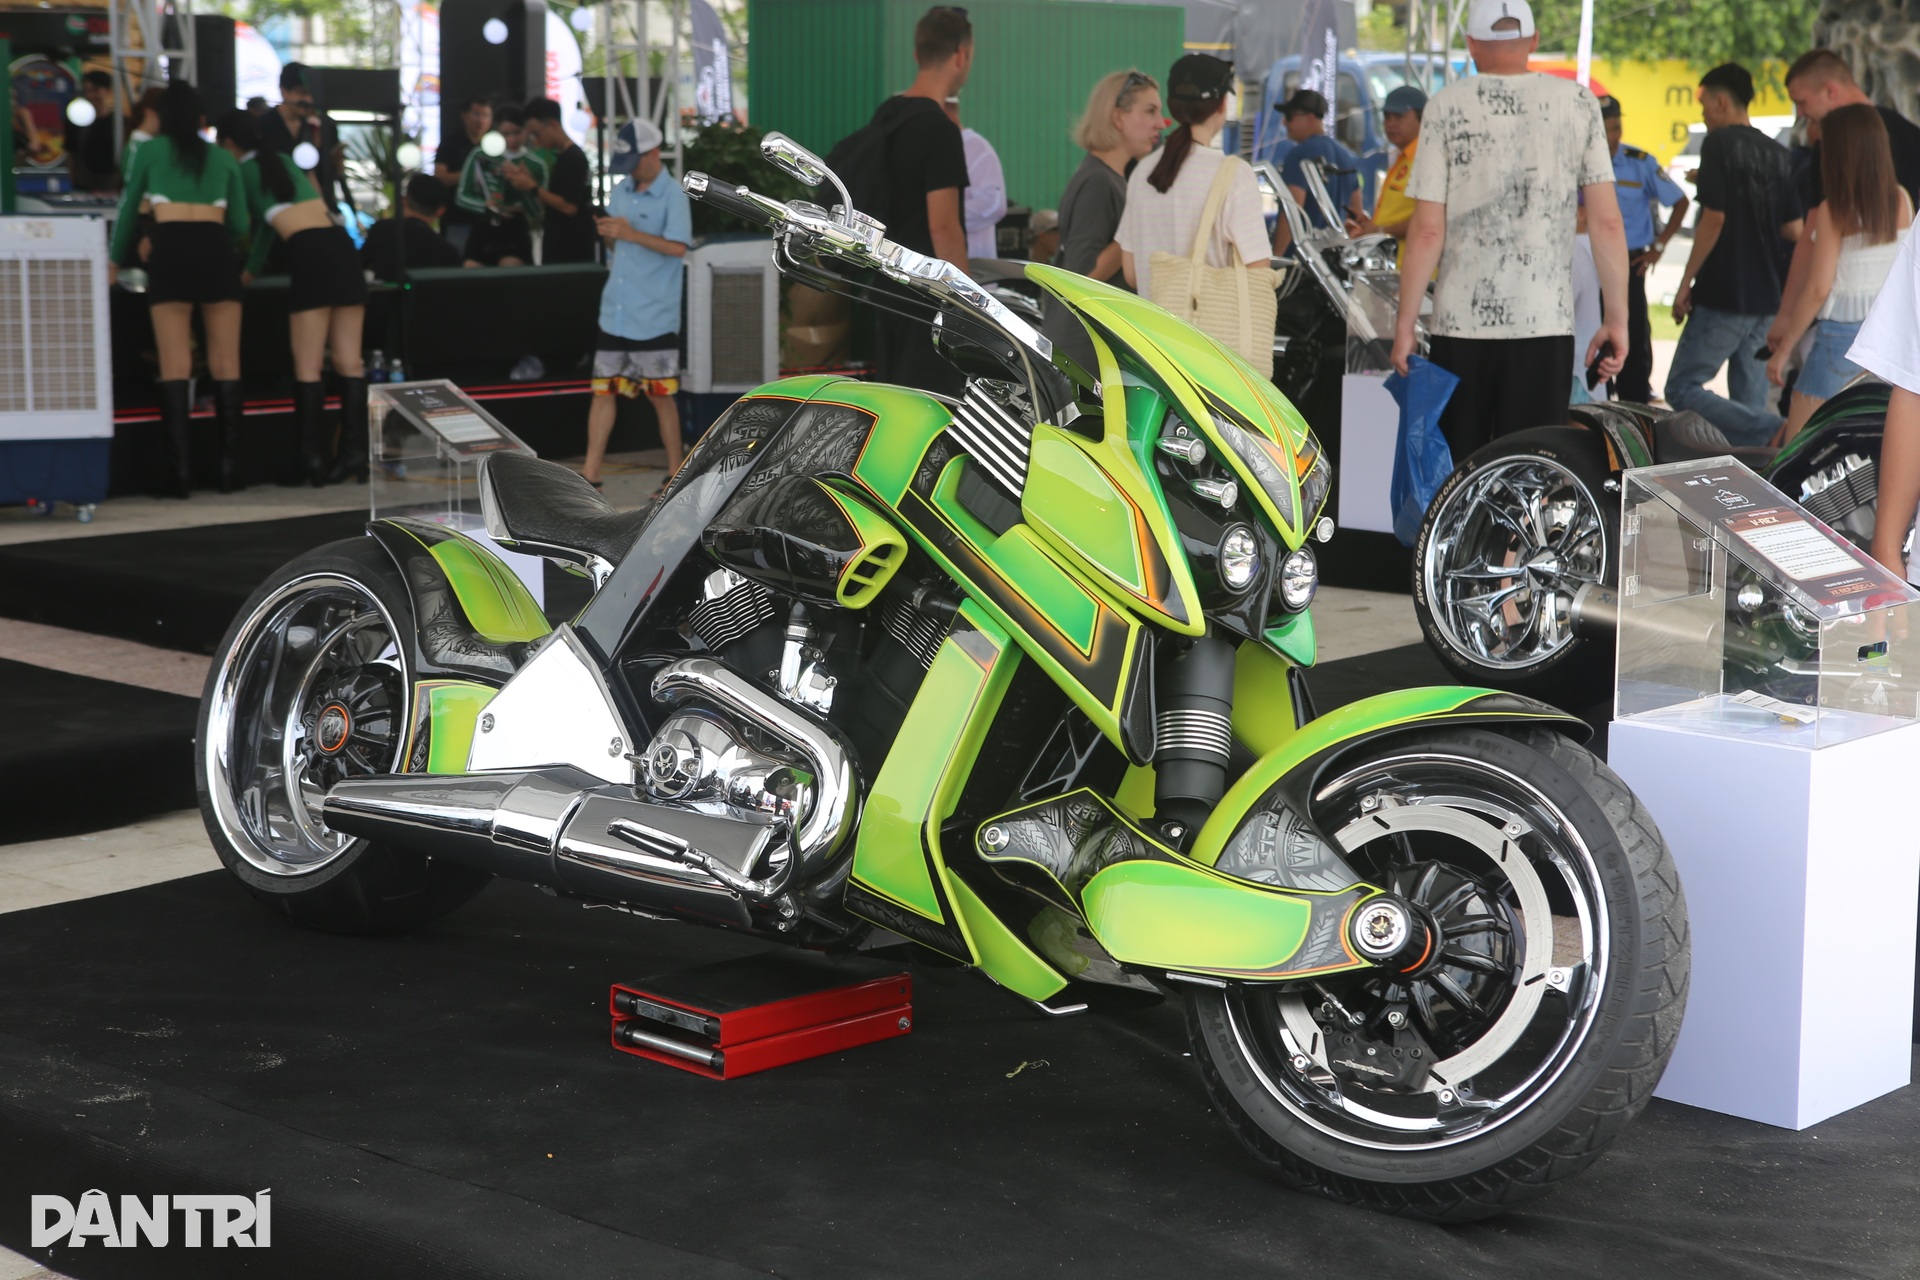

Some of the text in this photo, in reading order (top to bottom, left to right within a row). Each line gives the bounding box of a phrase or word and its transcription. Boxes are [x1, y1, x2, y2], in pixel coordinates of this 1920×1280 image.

[1416, 471, 1463, 606] AVON COBRA CHROME
[1749, 516, 1780, 526] V-REX
